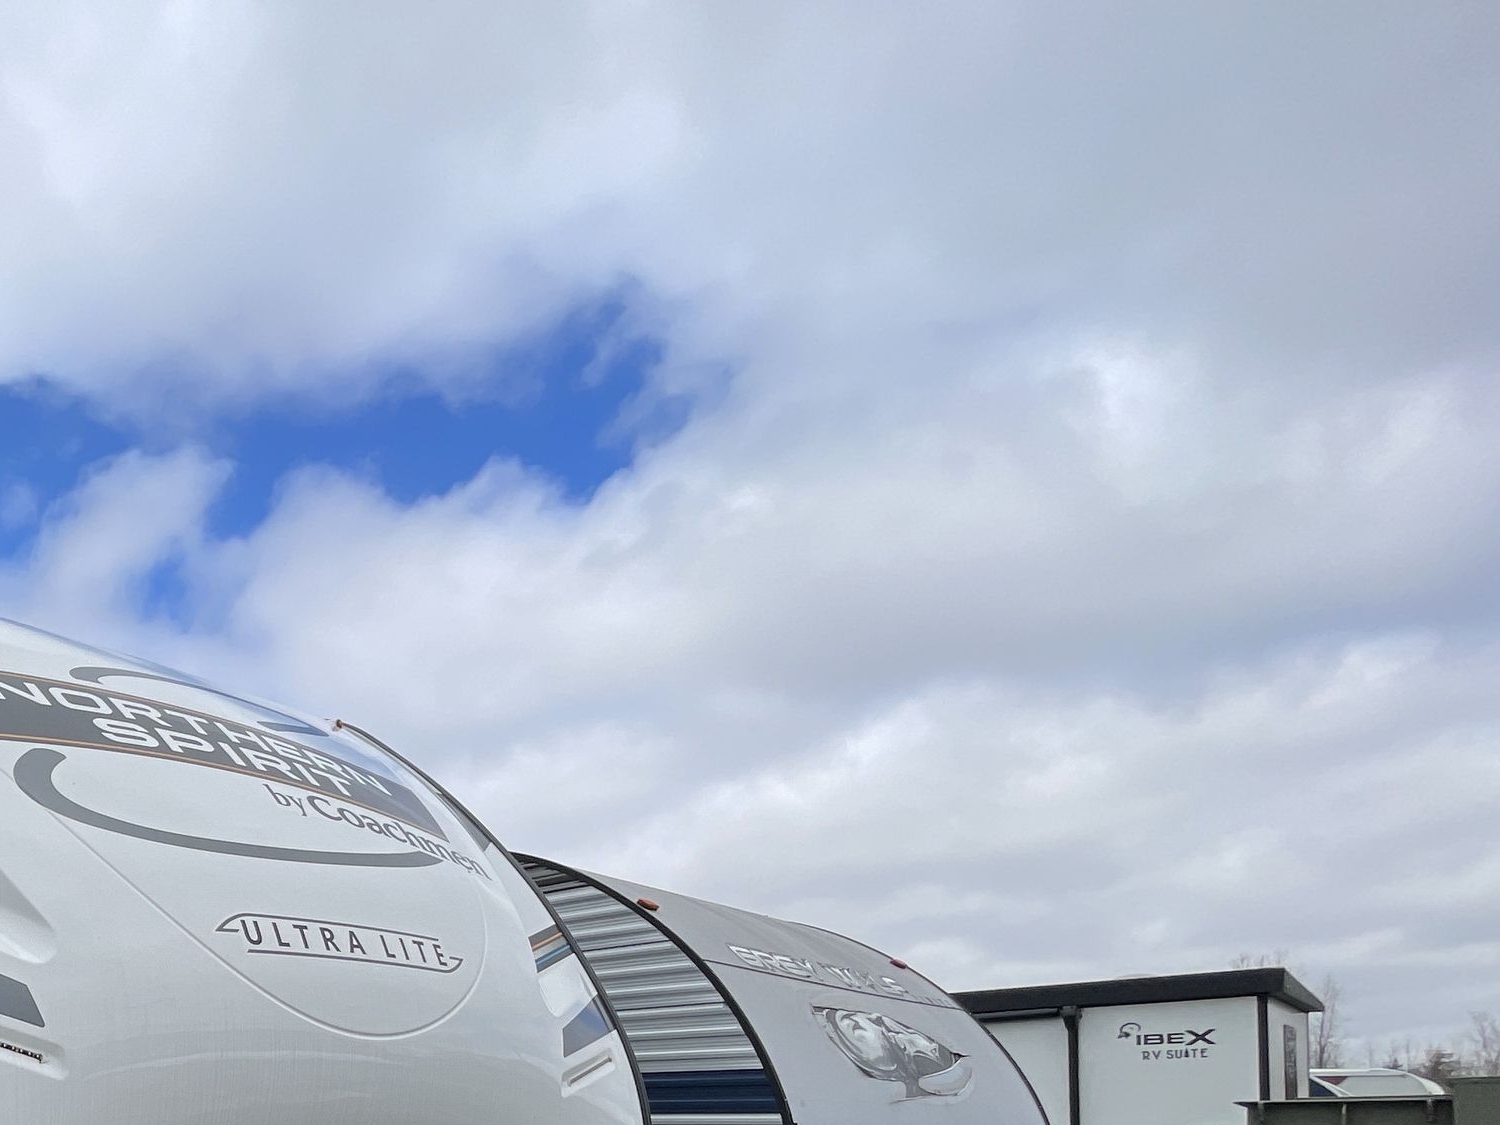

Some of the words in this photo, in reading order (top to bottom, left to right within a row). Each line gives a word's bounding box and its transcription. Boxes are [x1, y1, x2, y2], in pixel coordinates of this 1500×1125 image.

[92, 717, 352, 798] SPIRIT
[262, 783, 308, 817] by
[306, 795, 493, 881] Coachmen
[240, 919, 367, 955] ULTRA
[379, 934, 448, 967] LITE
[1135, 1028, 1217, 1046] IBEX
[1141, 1050, 1161, 1060] RV
